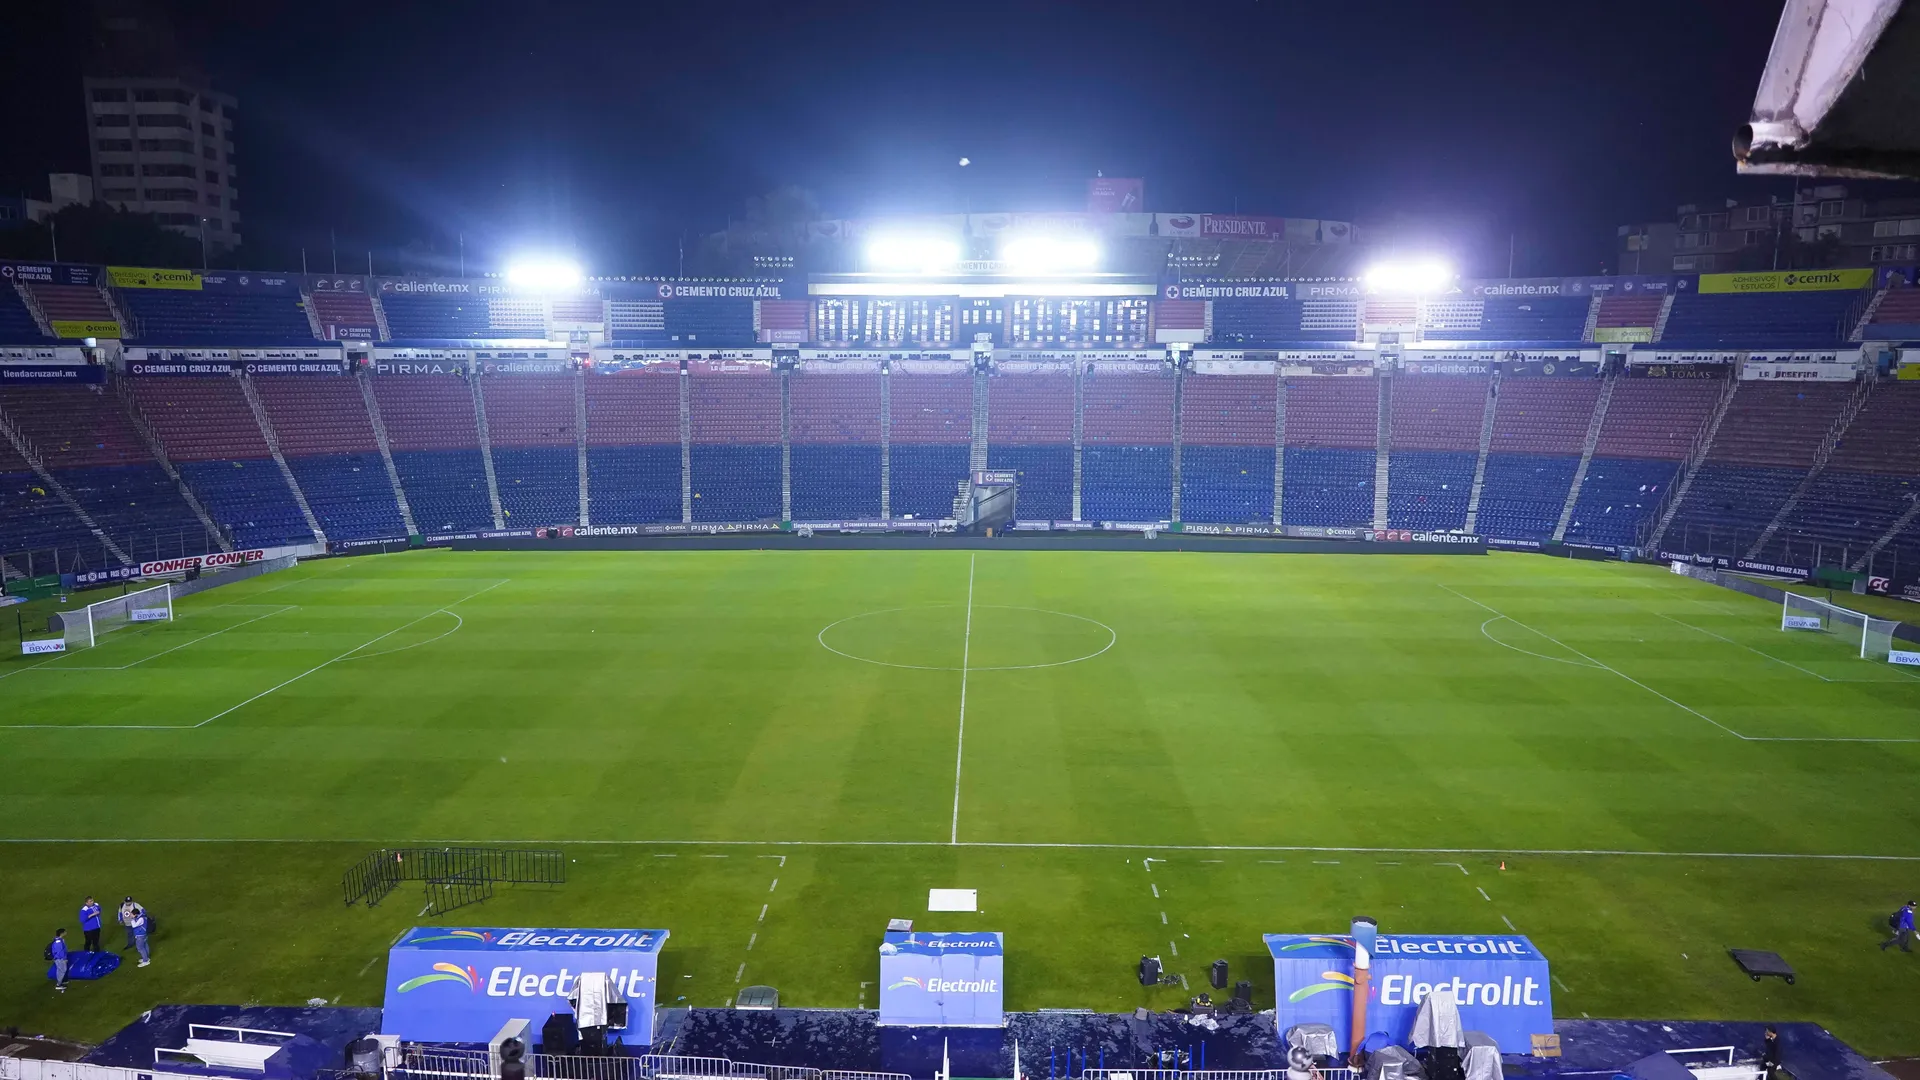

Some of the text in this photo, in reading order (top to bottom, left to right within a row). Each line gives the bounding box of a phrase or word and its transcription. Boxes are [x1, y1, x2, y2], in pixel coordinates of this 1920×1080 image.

[1203, 216, 1266, 235] PRESIDENTE
[17, 265, 52, 273] CEMENTO
[163, 273, 195, 282] cemix
[1799, 273, 1840, 284] cemix
[395, 281, 469, 294] caliente.mx
[675, 286, 781, 297] CEMENTO CRUZ AZUL
[1183, 286, 1288, 297] CEMENTO CRUZ AZUL
[1311, 287, 1359, 296] PIRMA
[1484, 283, 1559, 295] caliente.mx
[144, 364, 232, 373] CEMENTO CRUZ AZUL
[257, 363, 340, 372] CEMENTO CRUZ AZUL
[377, 364, 443, 374] PIRMA
[496, 363, 560, 372] caliente.mx
[1144, 363, 1161, 371] AZUL
[1421, 363, 1487, 373] caliente.mx
[3, 370, 77, 378] tiendacruzazul.mx
[1671, 371, 1711, 379] TOMAS
[574, 526, 638, 536] caliente.mx
[736, 523, 769, 531] PIRMA
[1186, 525, 1270, 534] PIRMA PIRMA
[1334, 528, 1356, 536] cemix
[1412, 532, 1479, 544] caliente.mx
[142, 557, 202, 575] GONHER
[1745, 562, 1808, 576] CEMENTO CRUZ AZUL
[76, 574, 87, 582] PASE
[98, 571, 108, 579] AZUL
[130, 566, 140, 575] AZUL
